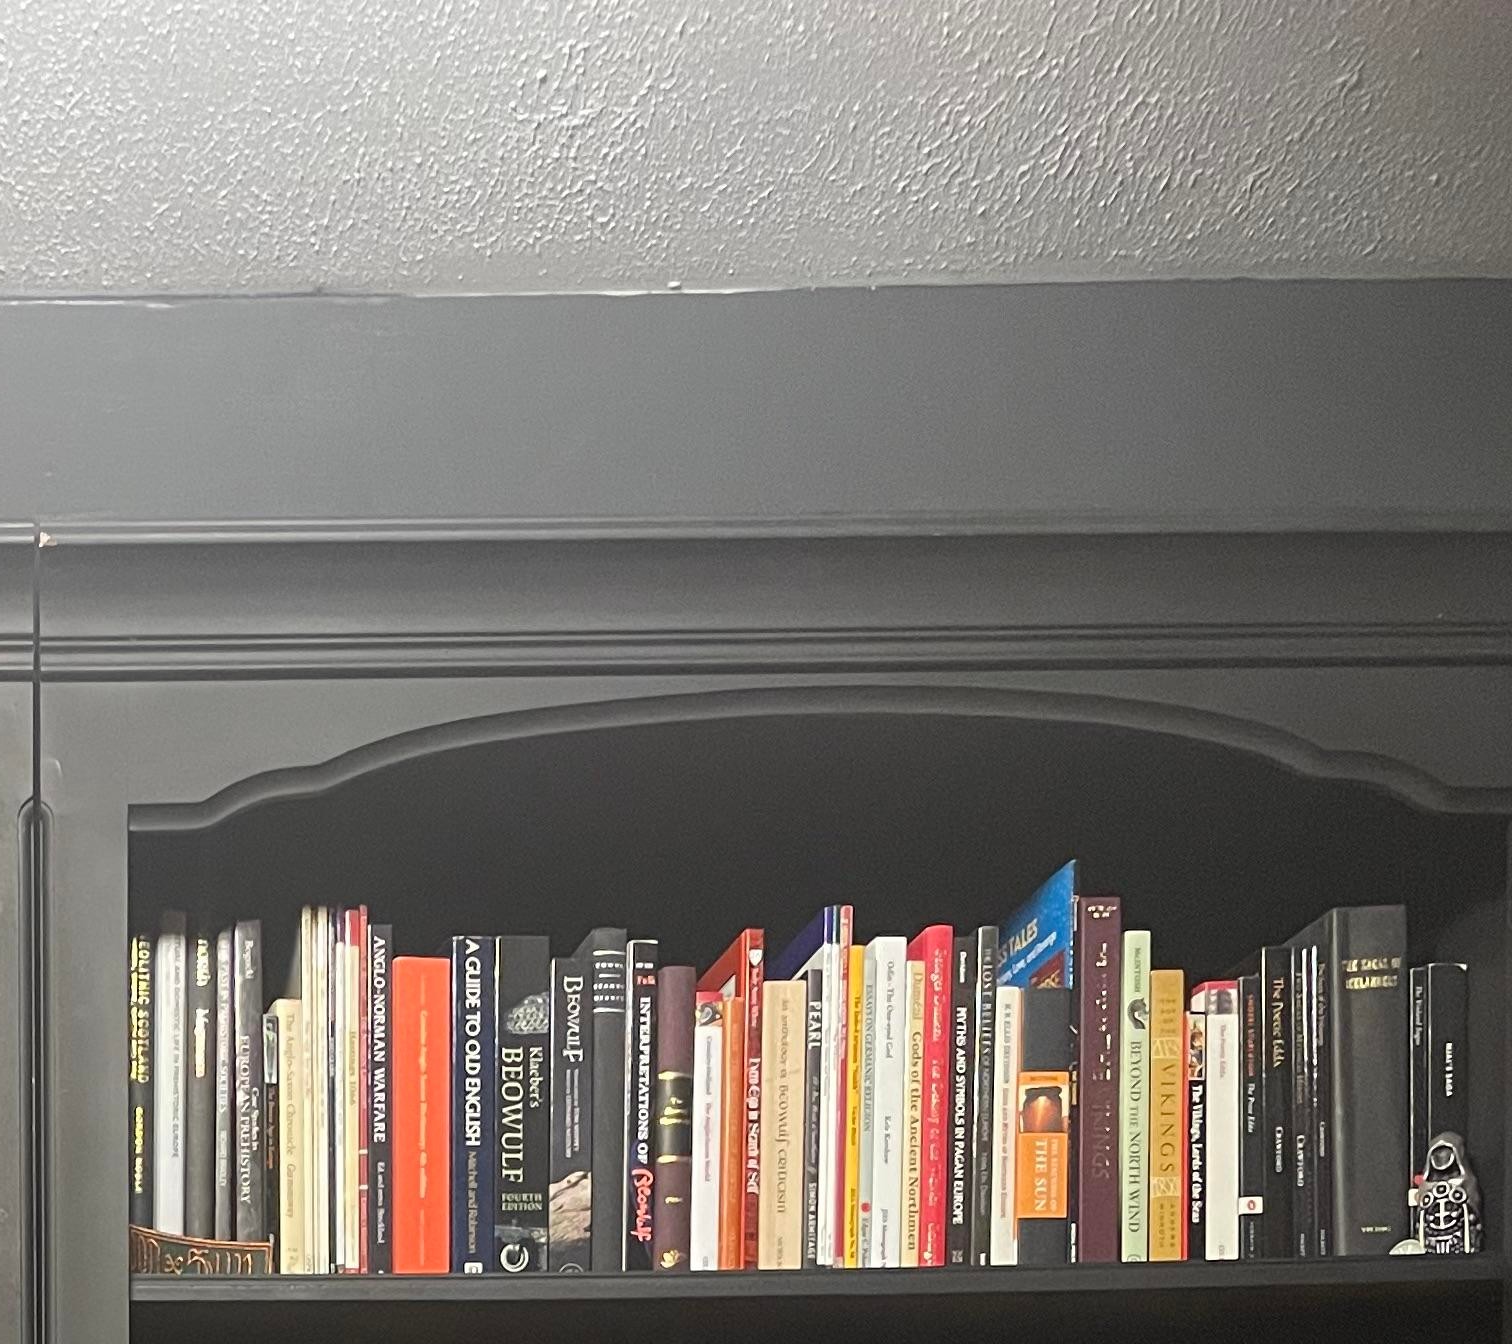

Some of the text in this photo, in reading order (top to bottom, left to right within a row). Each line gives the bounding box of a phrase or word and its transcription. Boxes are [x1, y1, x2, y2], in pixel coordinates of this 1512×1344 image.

[465, 940, 481, 1146] A GUIDE TO OLD ENGLISH
[529, 1047, 543, 1108] Klaeber's
[809, 1001, 821, 1049] PEARL
[501, 1047, 522, 1182] BEOWULF
[1128, 1041, 1142, 1232] BEYOND THE NORTH WIND
[1160, 1063, 1176, 1172] VIKINGS
[1035, 1139, 1048, 1210] THE SUN
